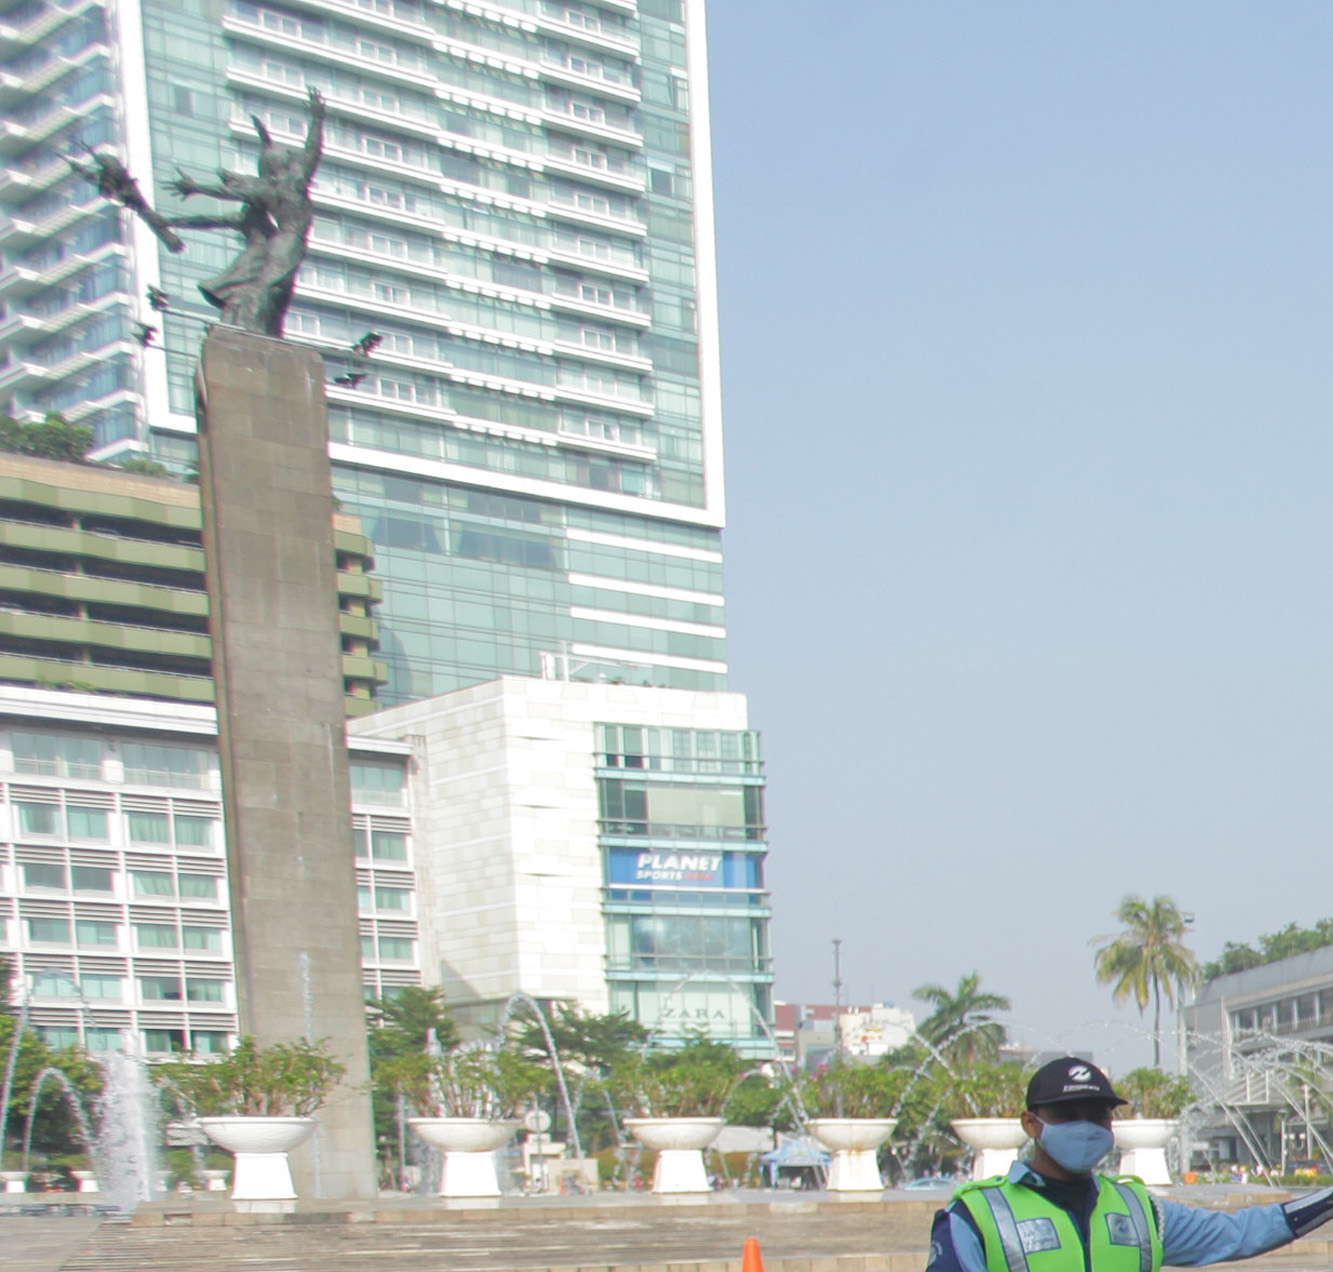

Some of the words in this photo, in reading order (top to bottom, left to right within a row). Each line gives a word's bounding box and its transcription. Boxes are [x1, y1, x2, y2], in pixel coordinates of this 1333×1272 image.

[637, 853, 723, 872] PLANET
[635, 869, 683, 881] SPORTS
[661, 1008, 726, 1019] ZARA
